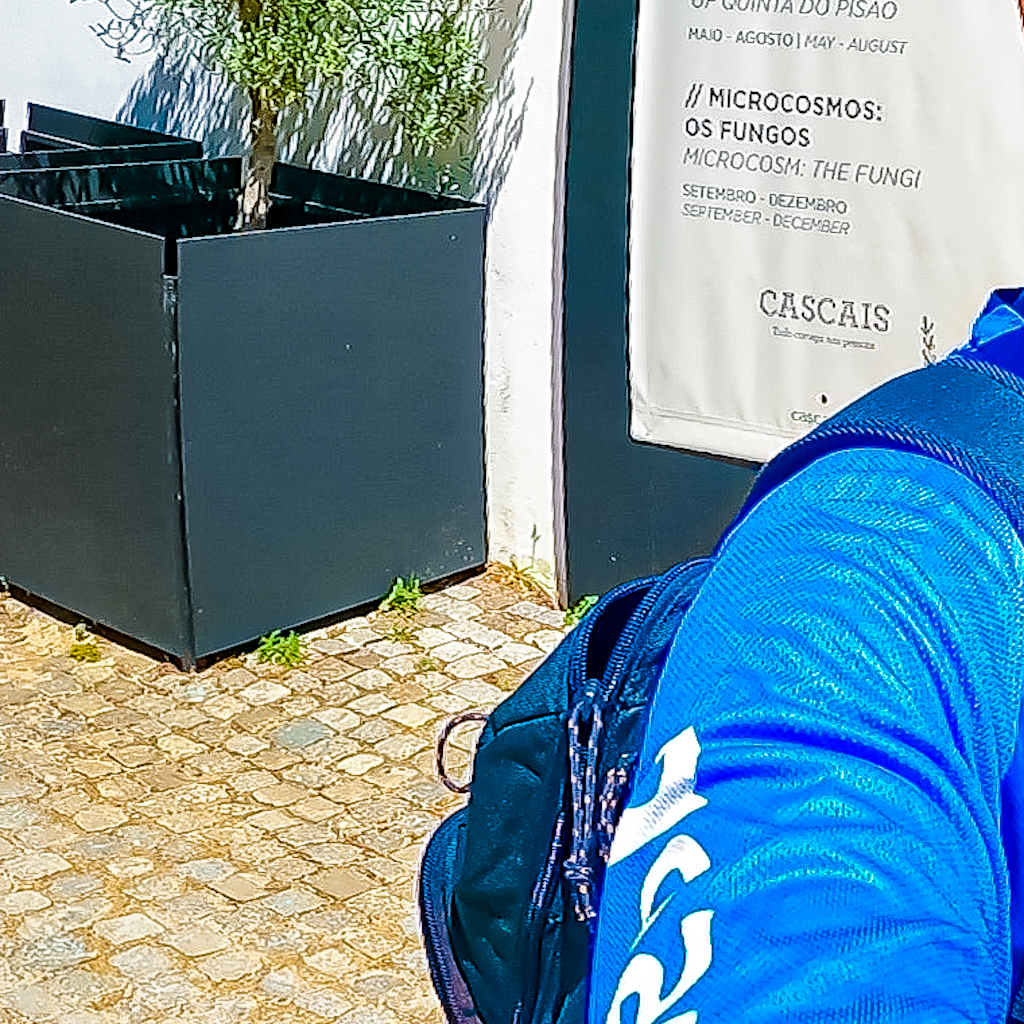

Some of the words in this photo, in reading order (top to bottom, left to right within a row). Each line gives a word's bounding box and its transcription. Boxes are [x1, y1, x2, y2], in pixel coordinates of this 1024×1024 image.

[735, 31, 794, 48] AGOSTO
[804, 34, 836, 50] MAY
[846, 38, 908, 55] AUGUST
[709, 87, 883, 122] MICROCOSMOS:
[685, 117, 713, 138] OS
[720, 121, 811, 147] FUNGOS
[683, 147, 806, 177] MICROCOSM:
[813, 160, 851, 182] THE
[855, 164, 922, 189] FUNGI
[683, 183, 757, 204] SETEMBRO
[769, 193, 848, 215] DEZEMBRO
[681, 203, 762, 225] SEPTEMBER
[773, 214, 851, 235] DECEMBER
[760, 289, 890, 333] CASCAIS
